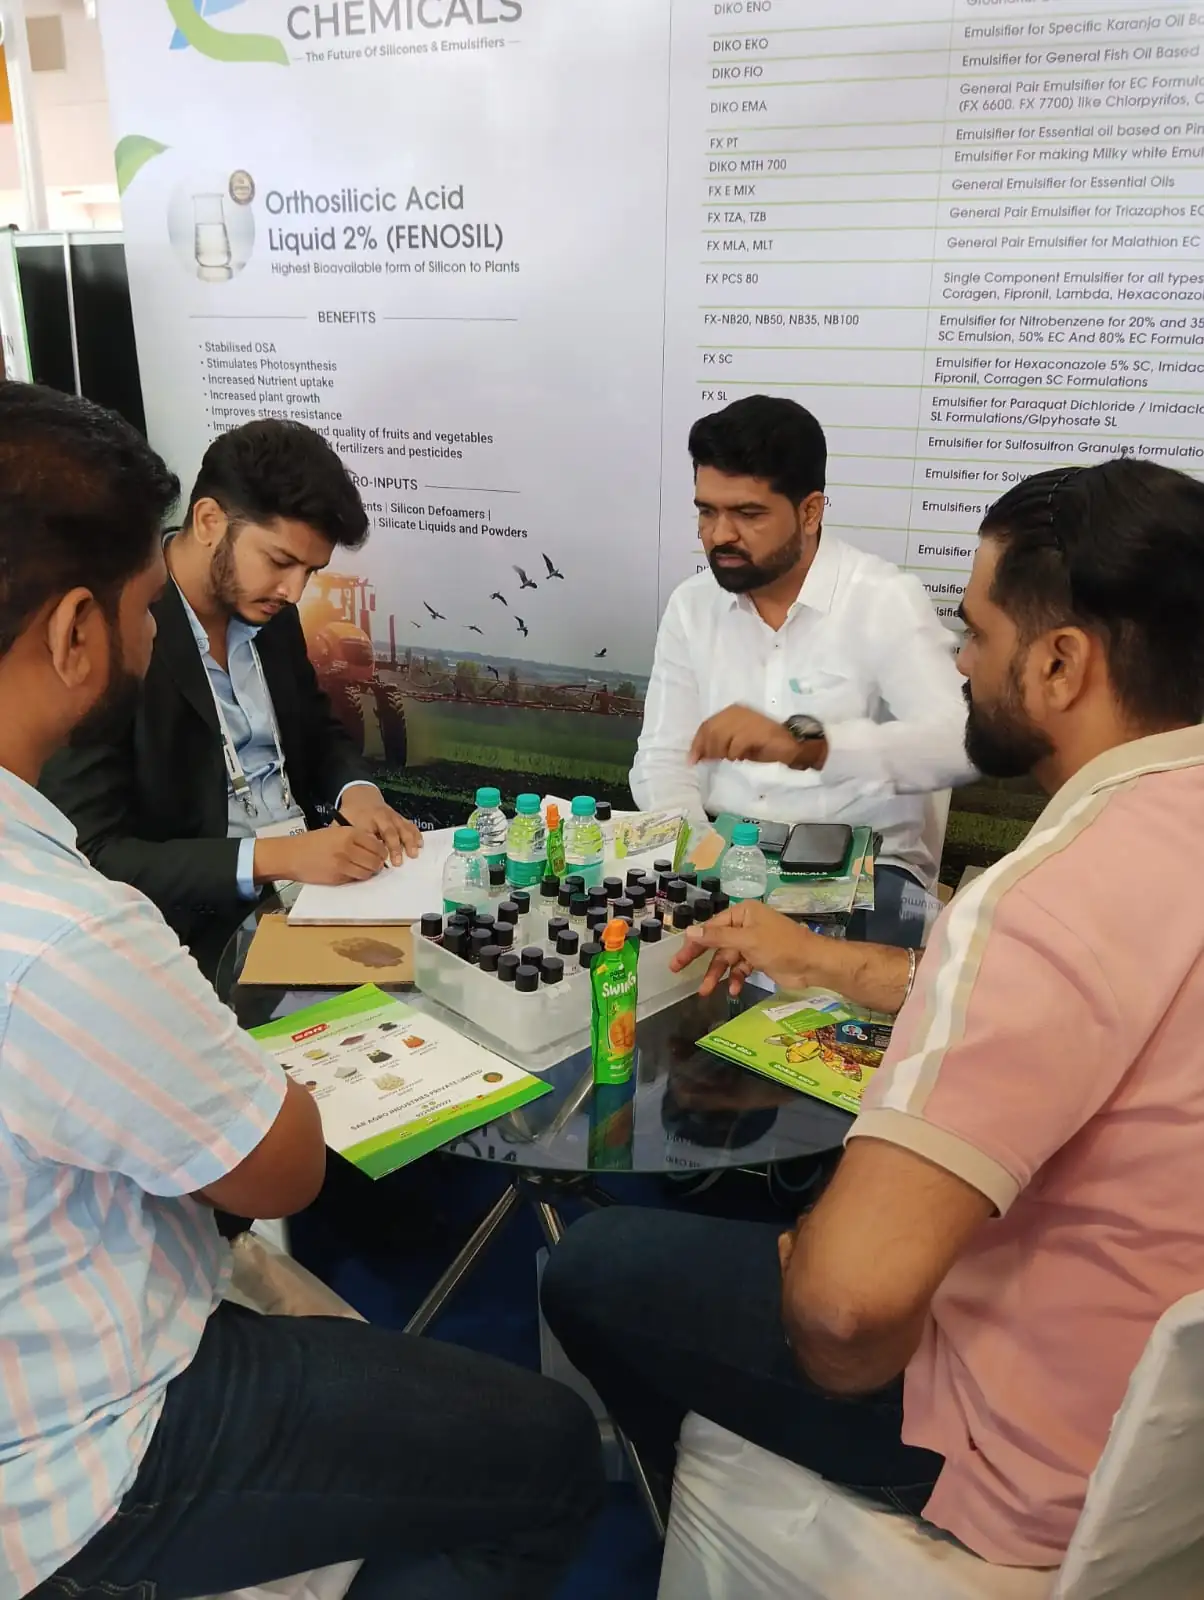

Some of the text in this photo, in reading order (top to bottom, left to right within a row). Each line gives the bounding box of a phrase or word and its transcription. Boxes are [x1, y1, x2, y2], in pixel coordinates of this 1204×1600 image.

[714, 0, 772, 16] DIKO ENO
[287, 0, 522, 41] CHEMICALS
[306, 36, 505, 63] The Future Of Silicones & Emulsifiers
[713, 38, 769, 52] DIKO EKO
[962, 44, 1200, 67] Emulsifier for General Fish Oil Based
[712, 66, 763, 79] DIKO FIO
[710, 100, 768, 114] DIKO EMA
[710, 137, 739, 149] FX PT
[709, 158, 787, 172] DIKO MTH 700
[708, 184, 756, 197] FX E MIX
[266, 185, 464, 214] Orthosilicic Acid
[707, 212, 721, 223] FX
[749, 211, 767, 222] TZB
[268, 223, 503, 255] Liquid 2% (FENOSIL)
[706, 240, 720, 252] FX
[752, 239, 774, 251] MLT
[947, 235, 1200, 249] General Pair Emulsifier for Malathion EC
[271, 259, 520, 277] Highest Bioavailable form of Silicon to Plants
[705, 273, 759, 285] FX PCS 80
[944, 272, 981, 286] Single
[984, 272, 1060, 285] Component
[1064, 272, 1124, 284] Emulsifier
[1127, 272, 1145, 284] for
[1148, 272, 1164, 284] all
[318, 310, 376, 324] BENEFITS
[823, 315, 859, 326] NB100
[940, 314, 996, 327] Emulsifier
[1000, 315, 1016, 327] for
[1019, 315, 1104, 327] Nitrobenzene
[1108, 316, 1125, 328] for
[1129, 316, 1155, 328] 20%
[1159, 317, 1186, 329] and
[938, 331, 955, 342] SC
[1018, 332, 1044, 343] 50%
[1048, 332, 1065, 343] EC
[1068, 332, 1095, 343] And
[1099, 332, 1125, 343] 80%
[1129, 333, 1147, 344] EC
[205, 342, 276, 354] Stabilised OSA
[207, 358, 337, 373] Stimulates Photosynthesis
[703, 353, 733, 364] FX SC
[936, 357, 992, 369] Emulsifier
[995, 357, 1011, 369] for
[1014, 358, 1106, 371] Hexaconazole
[1110, 359, 1129, 371] 5%
[208, 375, 334, 390] Increased Nutrient uptake
[984, 373, 1042, 387] Corragen
[1046, 375, 1063, 386] SC
[1067, 375, 1148, 388] Formulations
[210, 391, 320, 405] Increased plant growth
[702, 390, 728, 401] FX SL
[932, 396, 987, 409] Emulsifier
[991, 397, 1007, 409] for
[1010, 398, 1067, 412] Paraquat
[1070, 400, 1135, 413] Dichloride
[212, 407, 342, 421] Improves stress resistance
[930, 411, 943, 422] SL
[1104, 416, 1118, 427] SL
[332, 426, 366, 440] quality
[369, 427, 380, 439] of
[382, 427, 410, 440] fruits
[412, 429, 432, 441] and
[434, 430, 493, 445] vegetables
[336, 441, 384, 455] fertilizers
[387, 444, 406, 457] and
[408, 445, 462, 460] pesticides
[928, 437, 983, 449] Emulsifier
[986, 438, 1002, 450] for
[1077, 441, 1135, 455] Granules
[925, 468, 980, 480] Emulsifier
[983, 470, 999, 481] for
[352, 475, 418, 490] RO-INPUTS
[390, 502, 424, 515] Silicon
[428, 505, 485, 519] Defoamers
[922, 501, 981, 513] Emulsifiers
[378, 517, 528, 539] Silicate Liquids and Powders
[918, 544, 971, 557] Emulsifier
[923, 584, 967, 595] mulsifier
